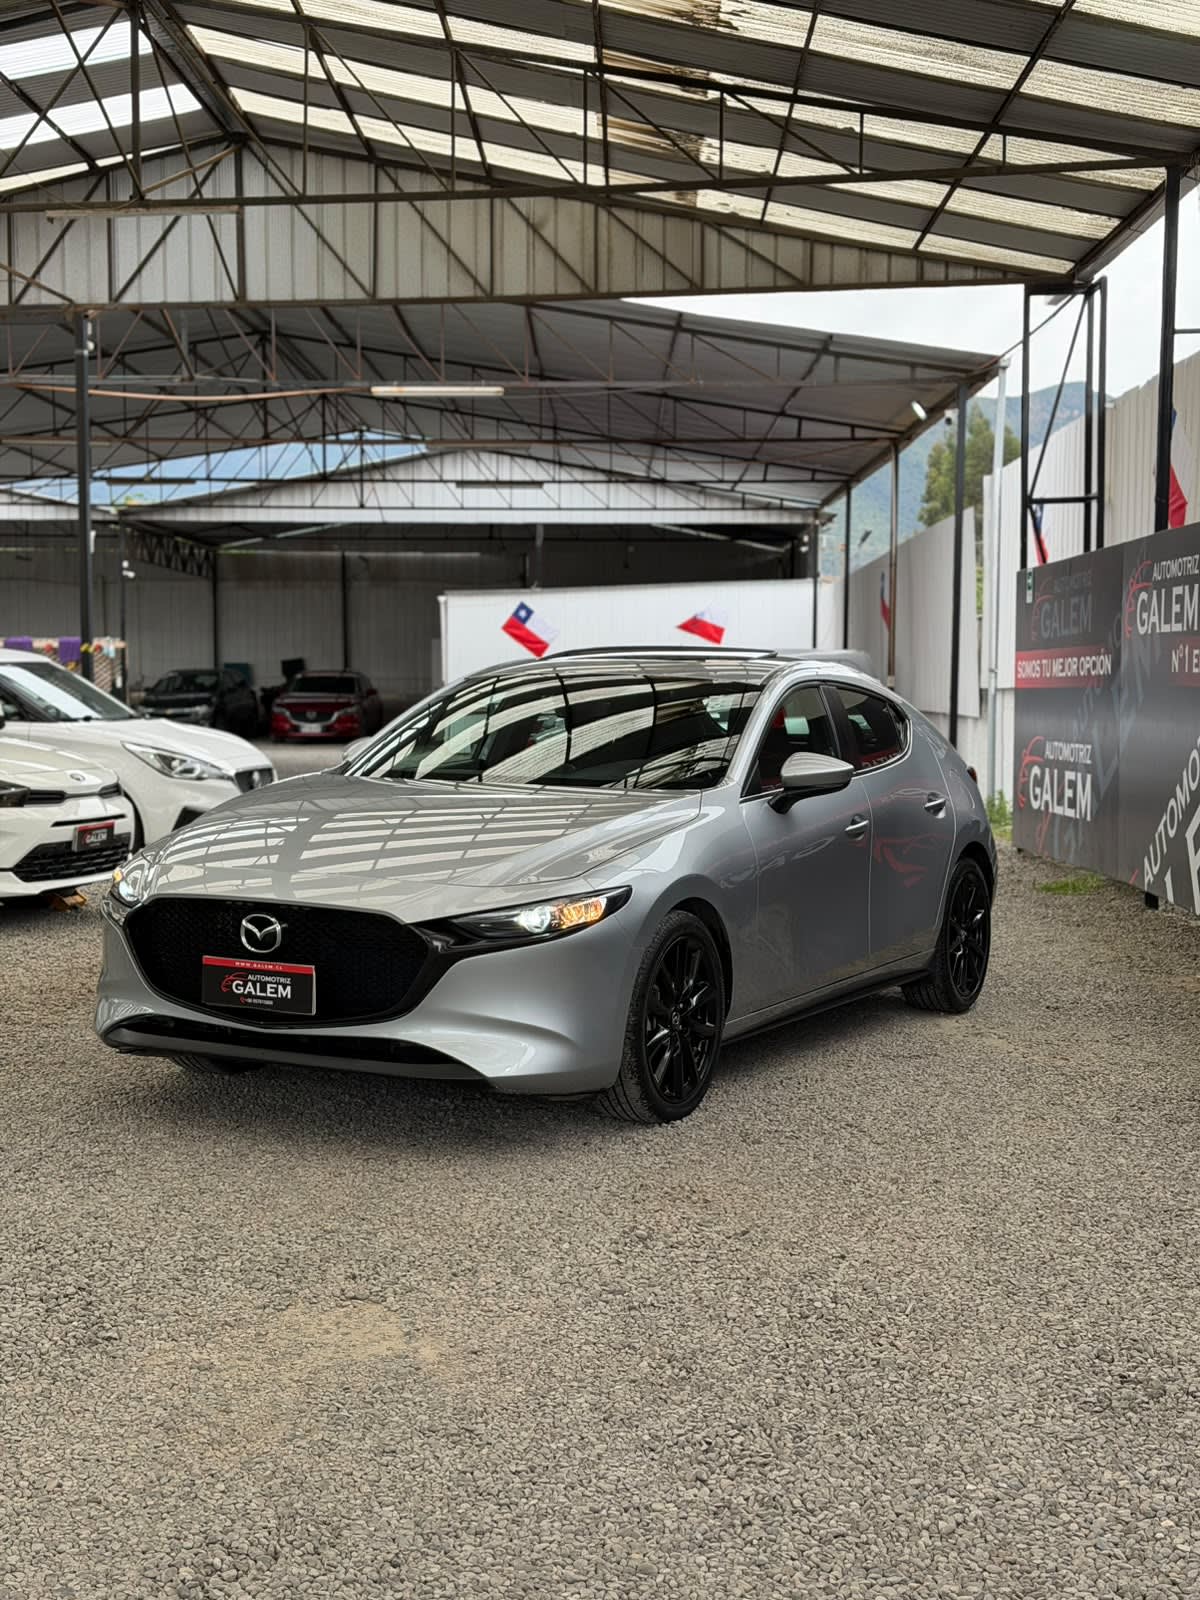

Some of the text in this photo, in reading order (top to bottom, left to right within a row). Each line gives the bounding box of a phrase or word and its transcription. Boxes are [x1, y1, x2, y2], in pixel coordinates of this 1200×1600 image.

[1152, 554, 1200, 581] AUTOMOTRIZ
[1040, 594, 1092, 639] GALEM
[1137, 583, 1199, 635] GALEM
[1017, 648, 1112, 679] SOMOS TU MEJOR OPCIÓN
[1192, 648, 1200, 673] E
[1045, 740, 1092, 764] AUTOMOTRIZ
[1029, 765, 1092, 821] GALEM
[1143, 735, 1200, 892] AUTOMO
[232, 980, 291, 999] GALEM
[248, 974, 291, 984] AUTOMOTRIZ
